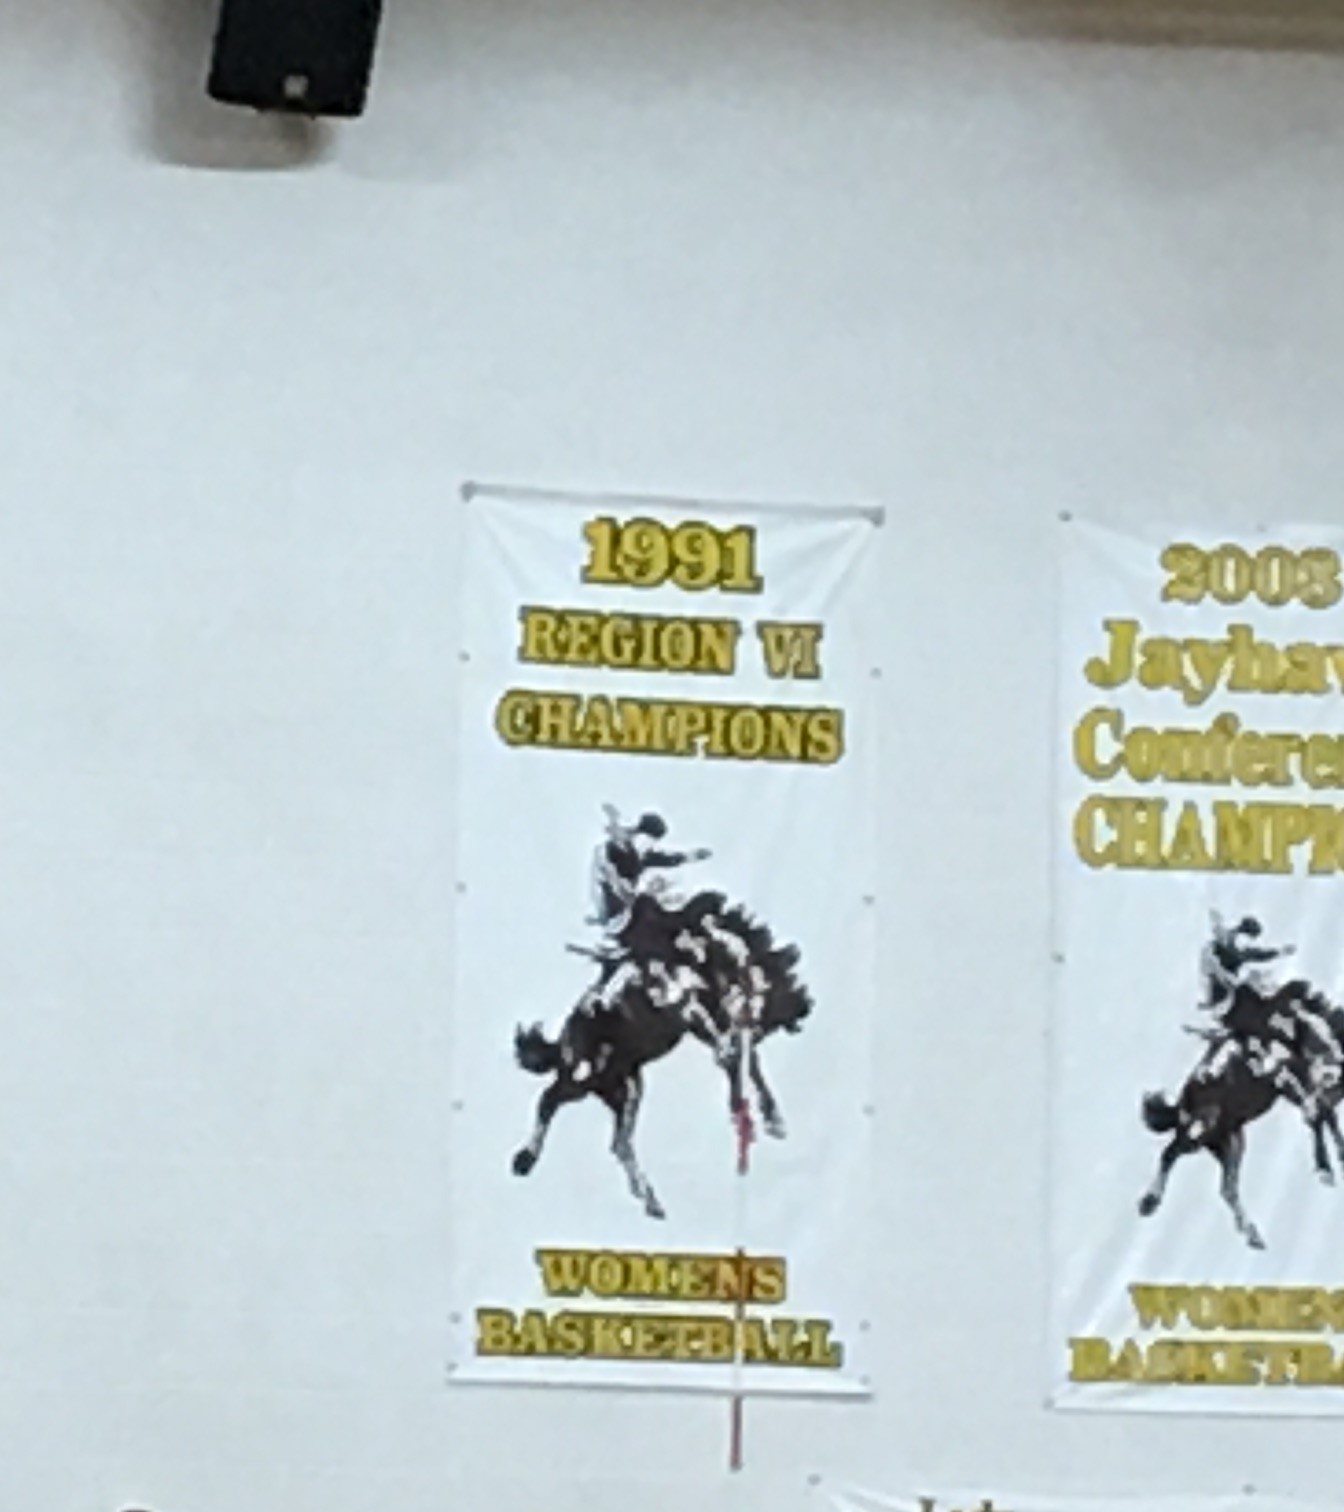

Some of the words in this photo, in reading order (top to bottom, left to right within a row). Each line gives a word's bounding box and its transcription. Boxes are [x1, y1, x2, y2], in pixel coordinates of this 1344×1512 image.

[581, 517, 763, 593] 1991
[519, 605, 742, 675] REGION
[757, 621, 823, 679] VI
[495, 689, 845, 764] CHAMPIONS
[536, 1248, 786, 1304] WOMENS
[476, 1308, 841, 1367] BASKETBALL
